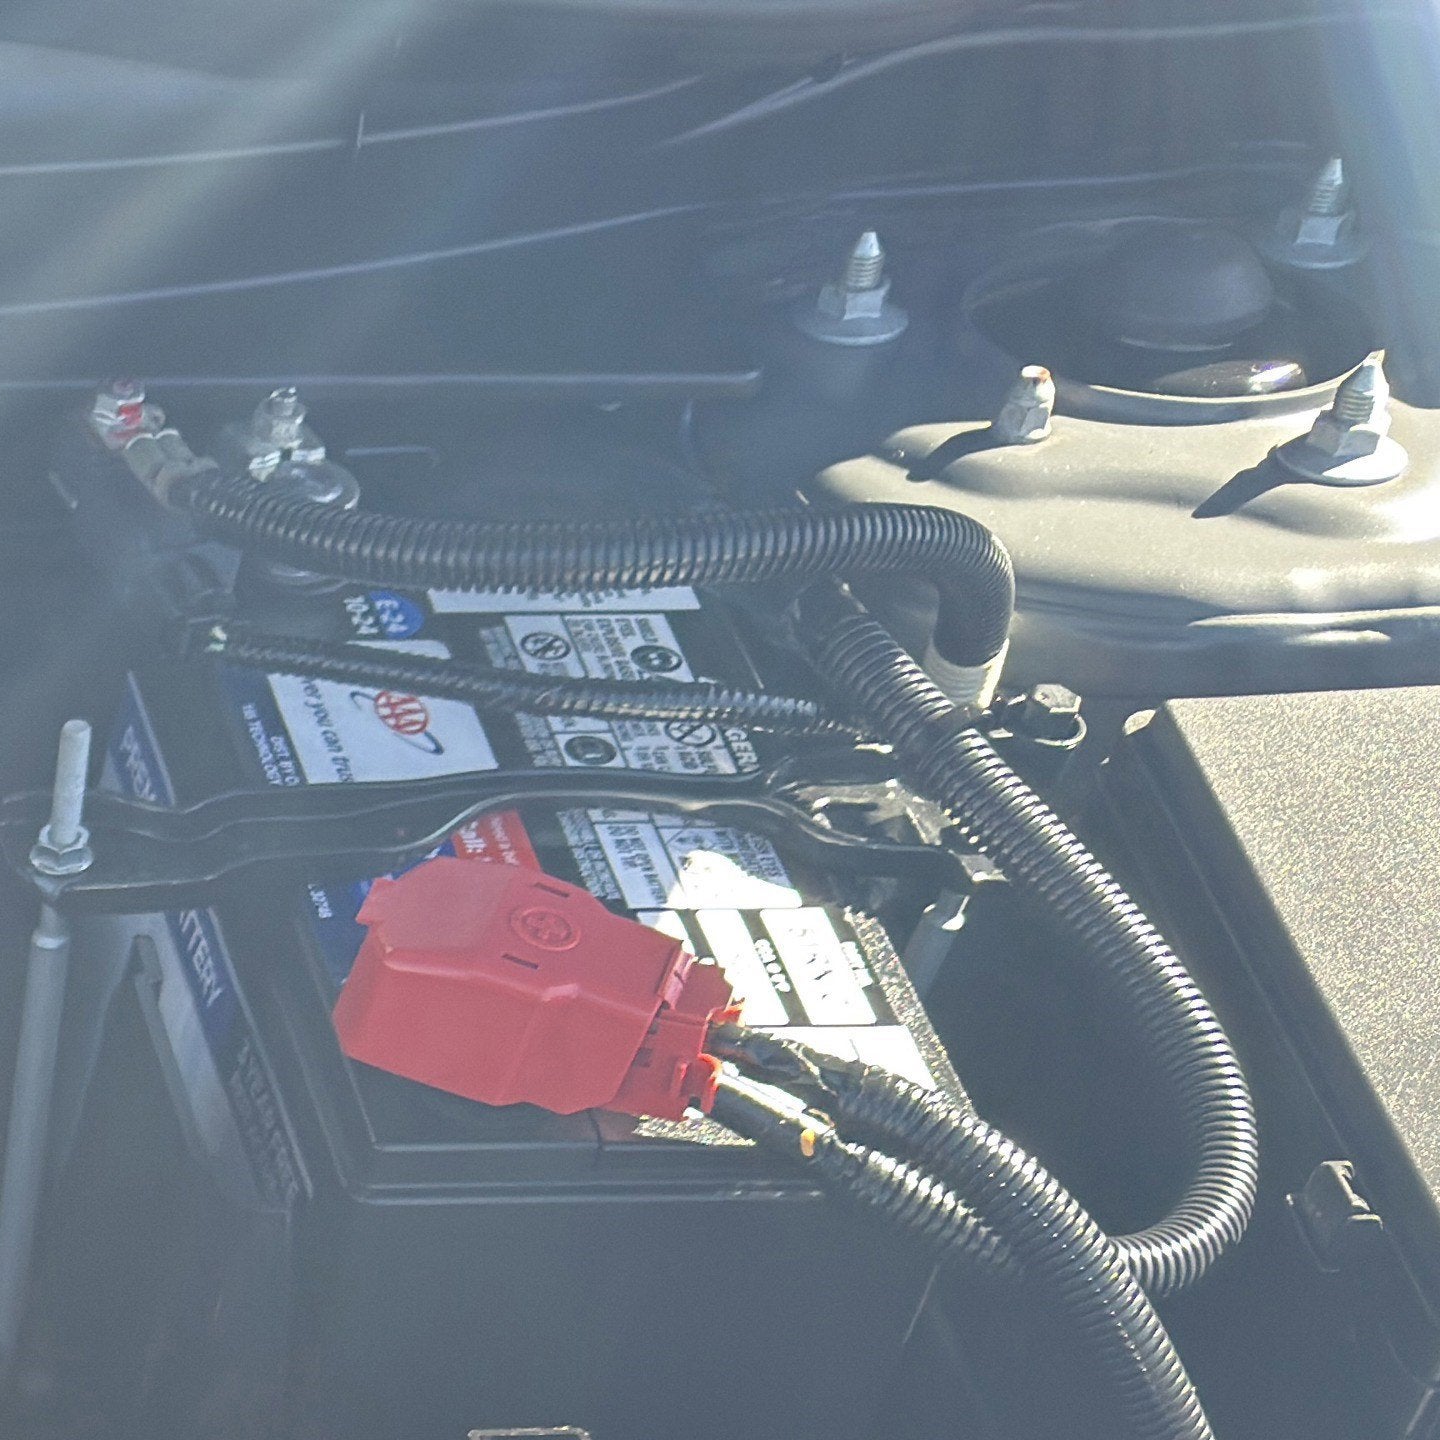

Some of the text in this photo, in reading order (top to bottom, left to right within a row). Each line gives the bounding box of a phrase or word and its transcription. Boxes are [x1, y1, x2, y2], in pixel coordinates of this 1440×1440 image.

[344, 596, 379, 634] 10-24
[375, 690, 429, 735] AAA
[321, 729, 344, 755] can
[331, 754, 356, 783] trus
